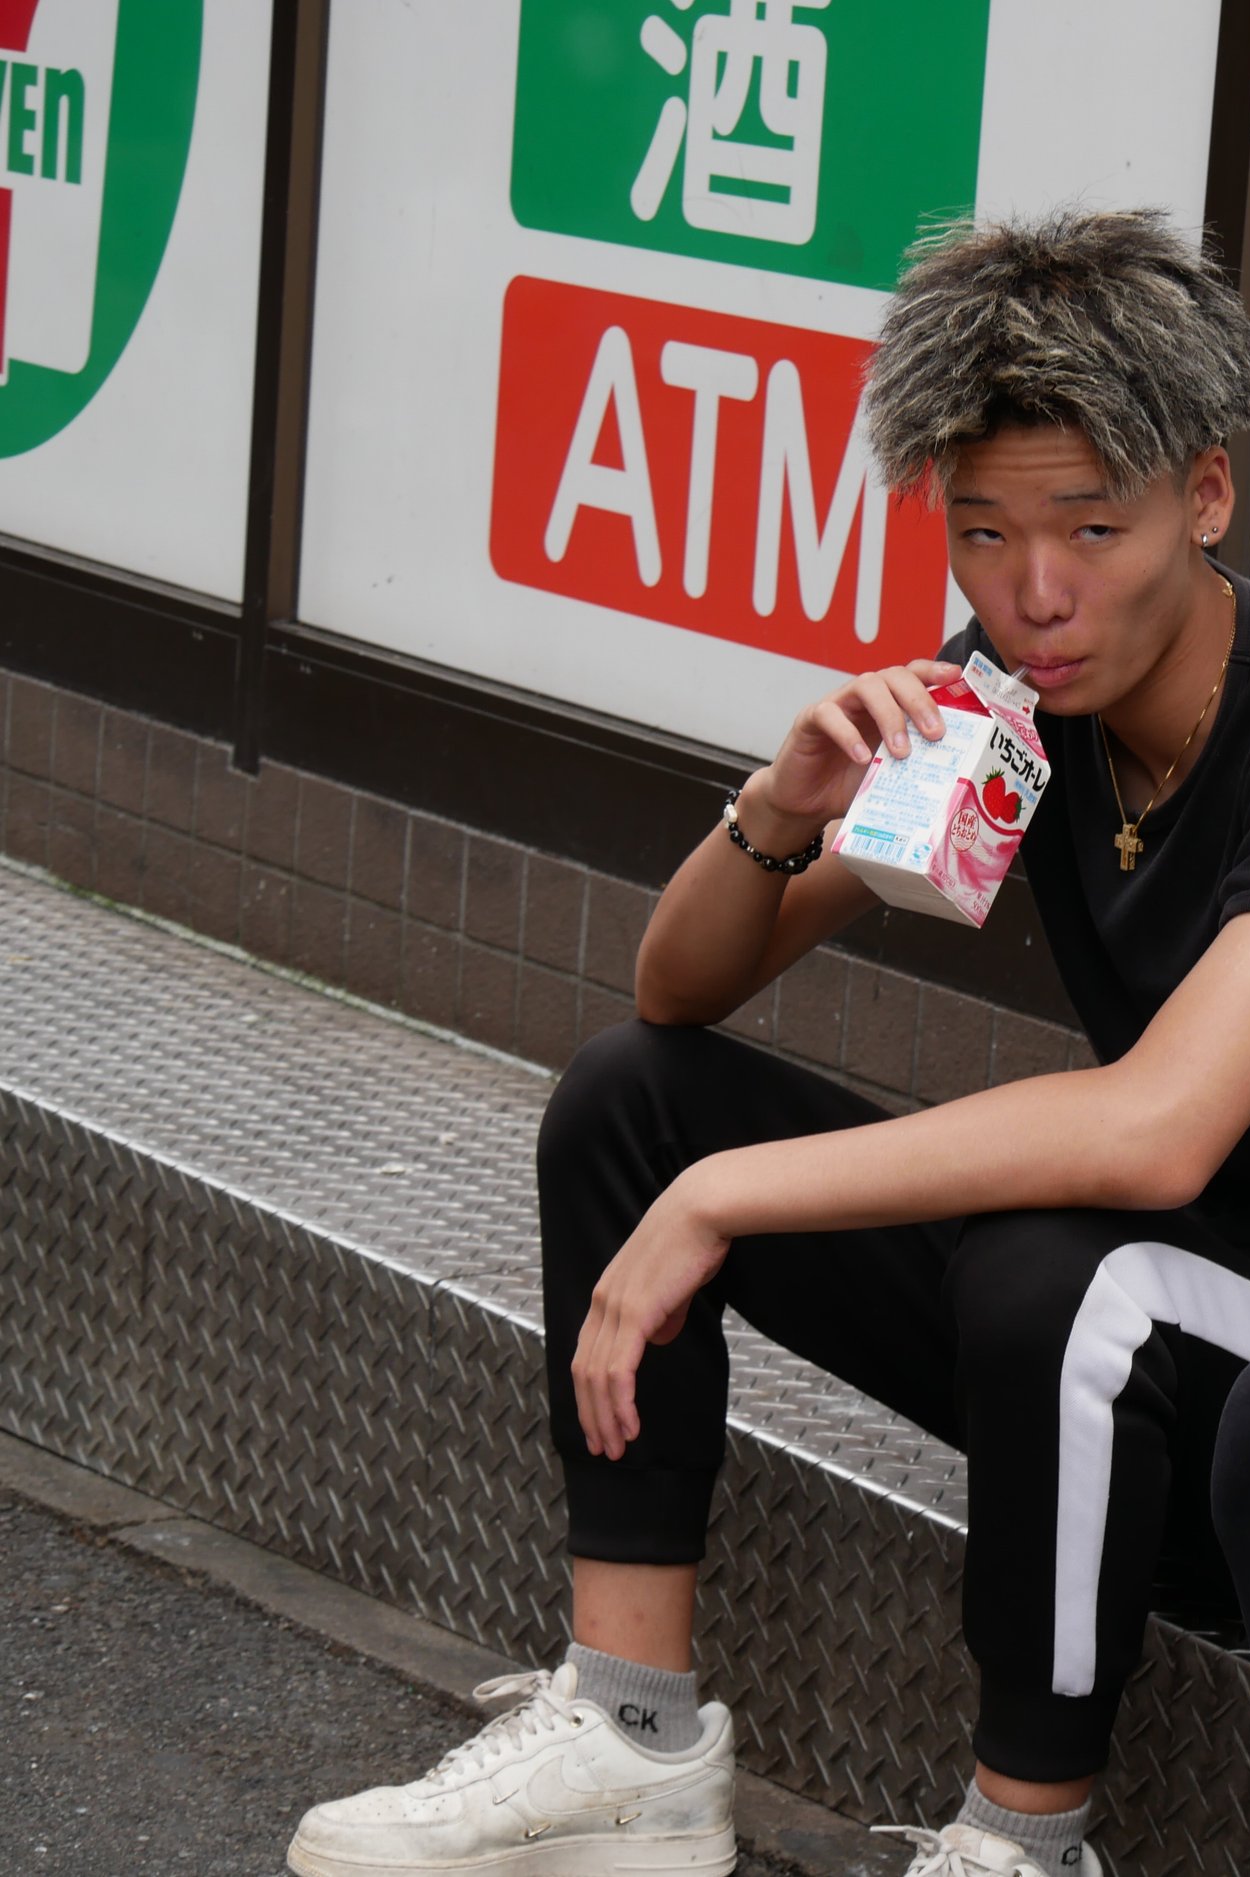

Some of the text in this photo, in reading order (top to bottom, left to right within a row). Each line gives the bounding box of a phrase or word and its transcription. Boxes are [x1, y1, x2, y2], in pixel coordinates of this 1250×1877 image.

[0, 60, 85, 185] En
[630, 0, 827, 245] 酒
[544, 325, 889, 643] ATM
[990, 726, 1046, 792] いちごオーレ
[958, 811, 977, 829] 国産
[618, 1703, 659, 1733] CK
